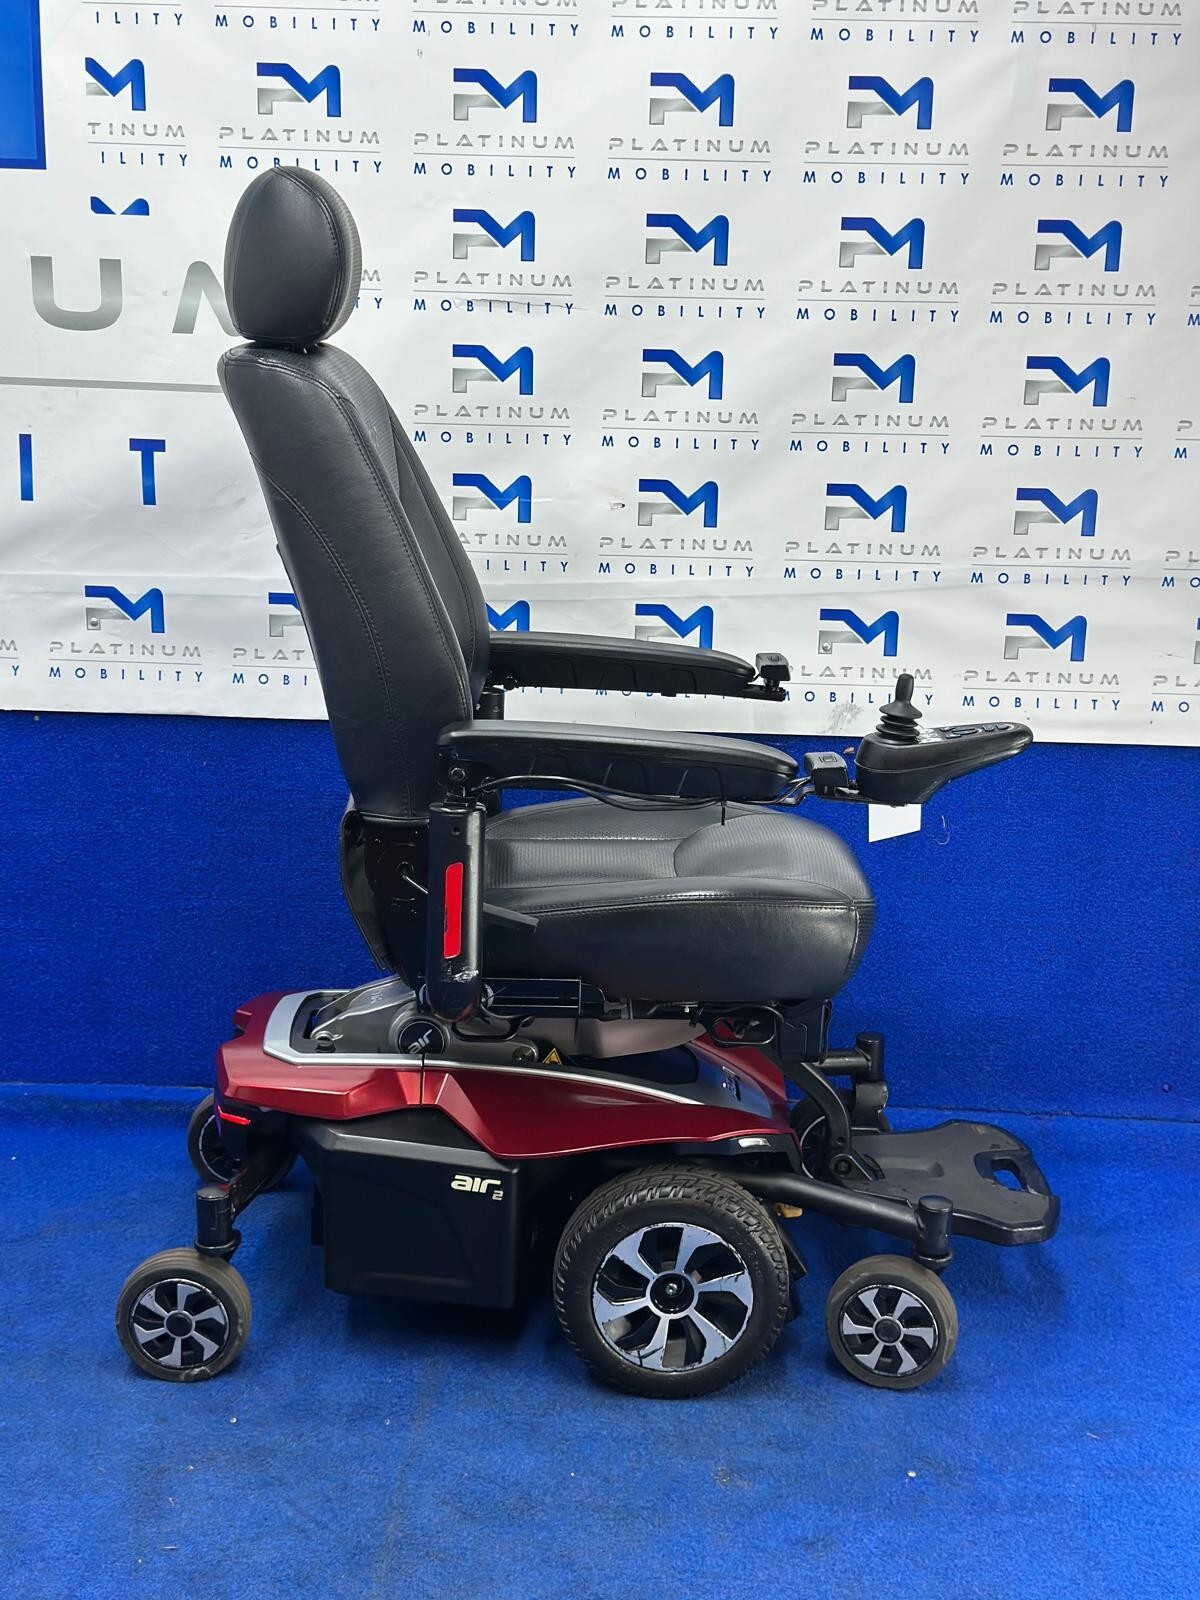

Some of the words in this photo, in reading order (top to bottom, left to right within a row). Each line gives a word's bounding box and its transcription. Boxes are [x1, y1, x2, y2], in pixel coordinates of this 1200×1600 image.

[1013, 1, 1181, 16] PLATINUM
[216, 15, 379, 31] MOBILITY
[413, 20, 578, 36] MOBILITY
[611, 25, 778, 39] MOBILITY
[811, 28, 978, 42] MOBILITY
[1011, 31, 1181, 45] MOBILITY
[219, 127, 379, 144] PLATINUM
[414, 133, 574, 149] PLATINUM
[609, 138, 770, 153] PLATINUM
[805, 141, 968, 155] PLATINUM
[1003, 144, 1168, 158] PLATINUM
[414, 163, 575, 178] MOBILITY
[608, 167, 771, 182] MOBILITY
[803, 171, 969, 184] MOBILITY
[1001, 173, 1168, 187] MOBILITY
[414, 271, 572, 287] PLATINUM
[606, 276, 764, 291] PLATINUM
[798, 280, 958, 294] PLATINUM
[992, 283, 1155, 297] PLATINUM
[414, 299, 573, 314] MOBILITY
[605, 304, 765, 318] MOBILITY
[797, 308, 958, 322] MOBILITY
[990, 311, 1155, 325] MOBILITY
[414, 404, 570, 419] PLATINUM
[603, 409, 758, 424] PLATINUM
[792, 413, 949, 428] PLATINUM
[982, 417, 1142, 431] PLATINUM
[414, 431, 571, 445] MOBILITY
[602, 436, 759, 450] MOBILITY
[790, 440, 949, 454] MOBILITY
[980, 444, 1142, 457] MOBILITY
[600, 537, 752, 551] PLATINUM
[785, 541, 940, 556] PLATINUM
[973, 546, 1131, 561] PLATINUM
[599, 563, 753, 577] MOBILITY
[784, 568, 941, 582] MOBILITY
[971, 572, 1131, 586] MOBILITY
[50, 642, 201, 657] PLATINUM
[49, 667, 202, 682] MOBILITY
[964, 670, 1119, 685] PLATINUM
[785, 691, 933, 705] OBILIY
[963, 696, 1120, 710] MOBILITY
[408, 1029, 432, 1054] air
[451, 1174, 501, 1193] air
[492, 1190, 504, 1201] 2
